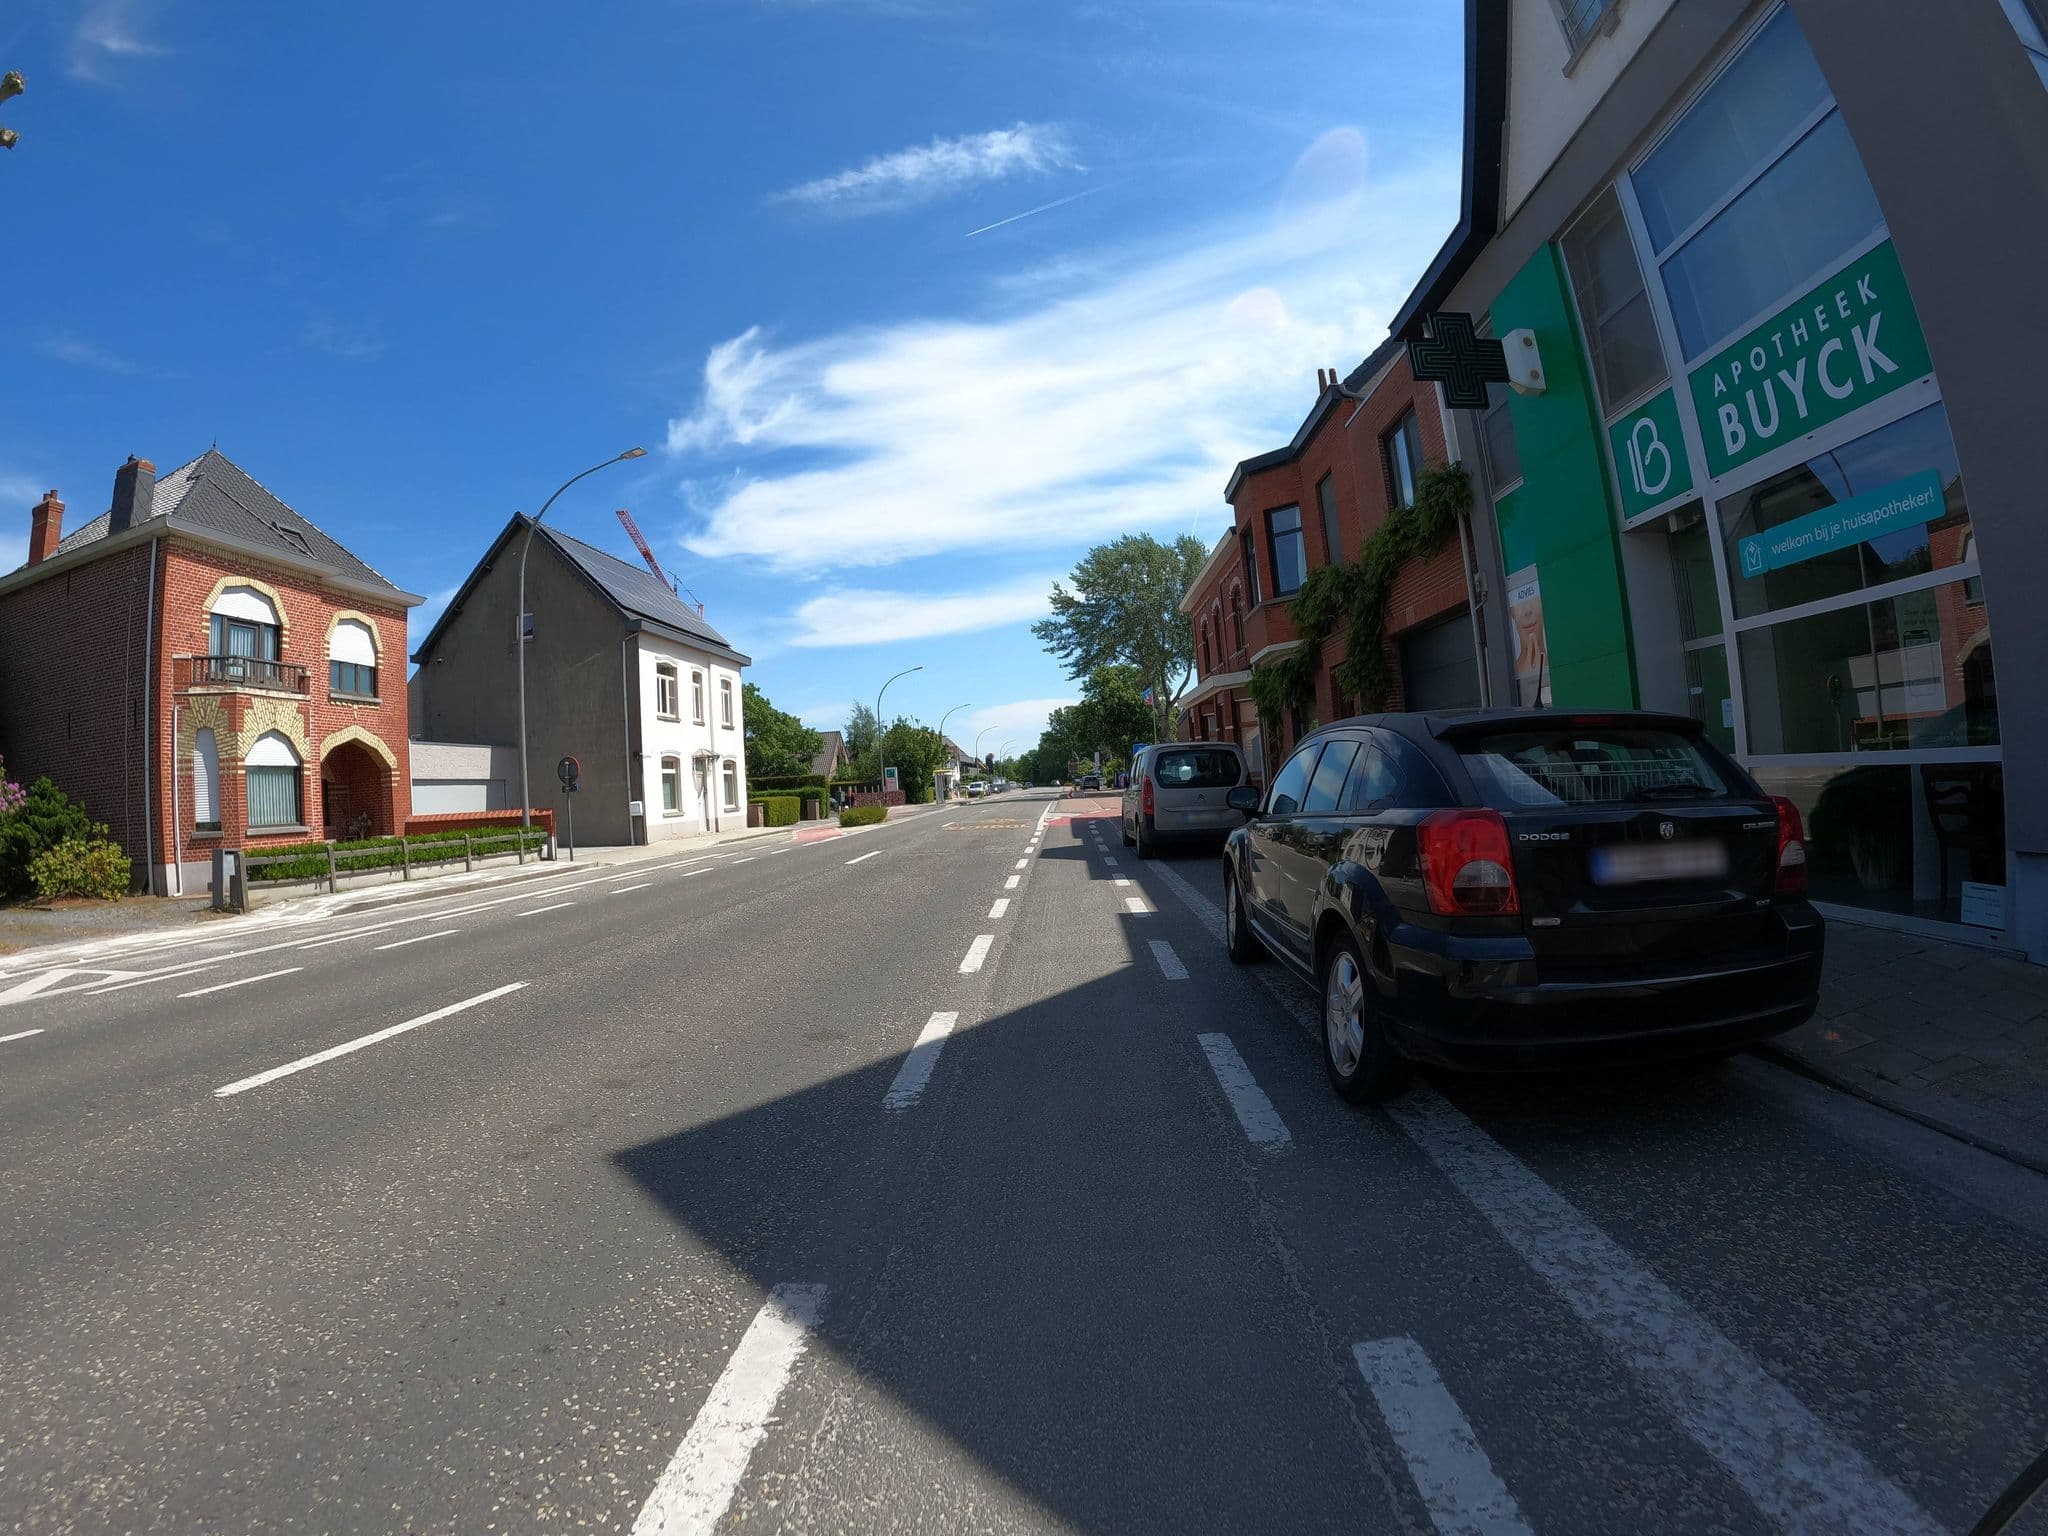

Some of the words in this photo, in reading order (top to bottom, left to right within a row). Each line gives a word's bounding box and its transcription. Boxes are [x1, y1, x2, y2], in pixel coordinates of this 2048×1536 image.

[1714, 273, 1878, 398] APOTHEEK
[1718, 311, 1900, 456] BUYCK
[1771, 530, 1814, 555] welkom
[1814, 525, 1830, 542] bij
[1830, 523, 1841, 540] je
[1842, 486, 1935, 532] huisapotheker!
[1517, 585, 1535, 600] ADVIES
[1519, 832, 1570, 841] DODGE
